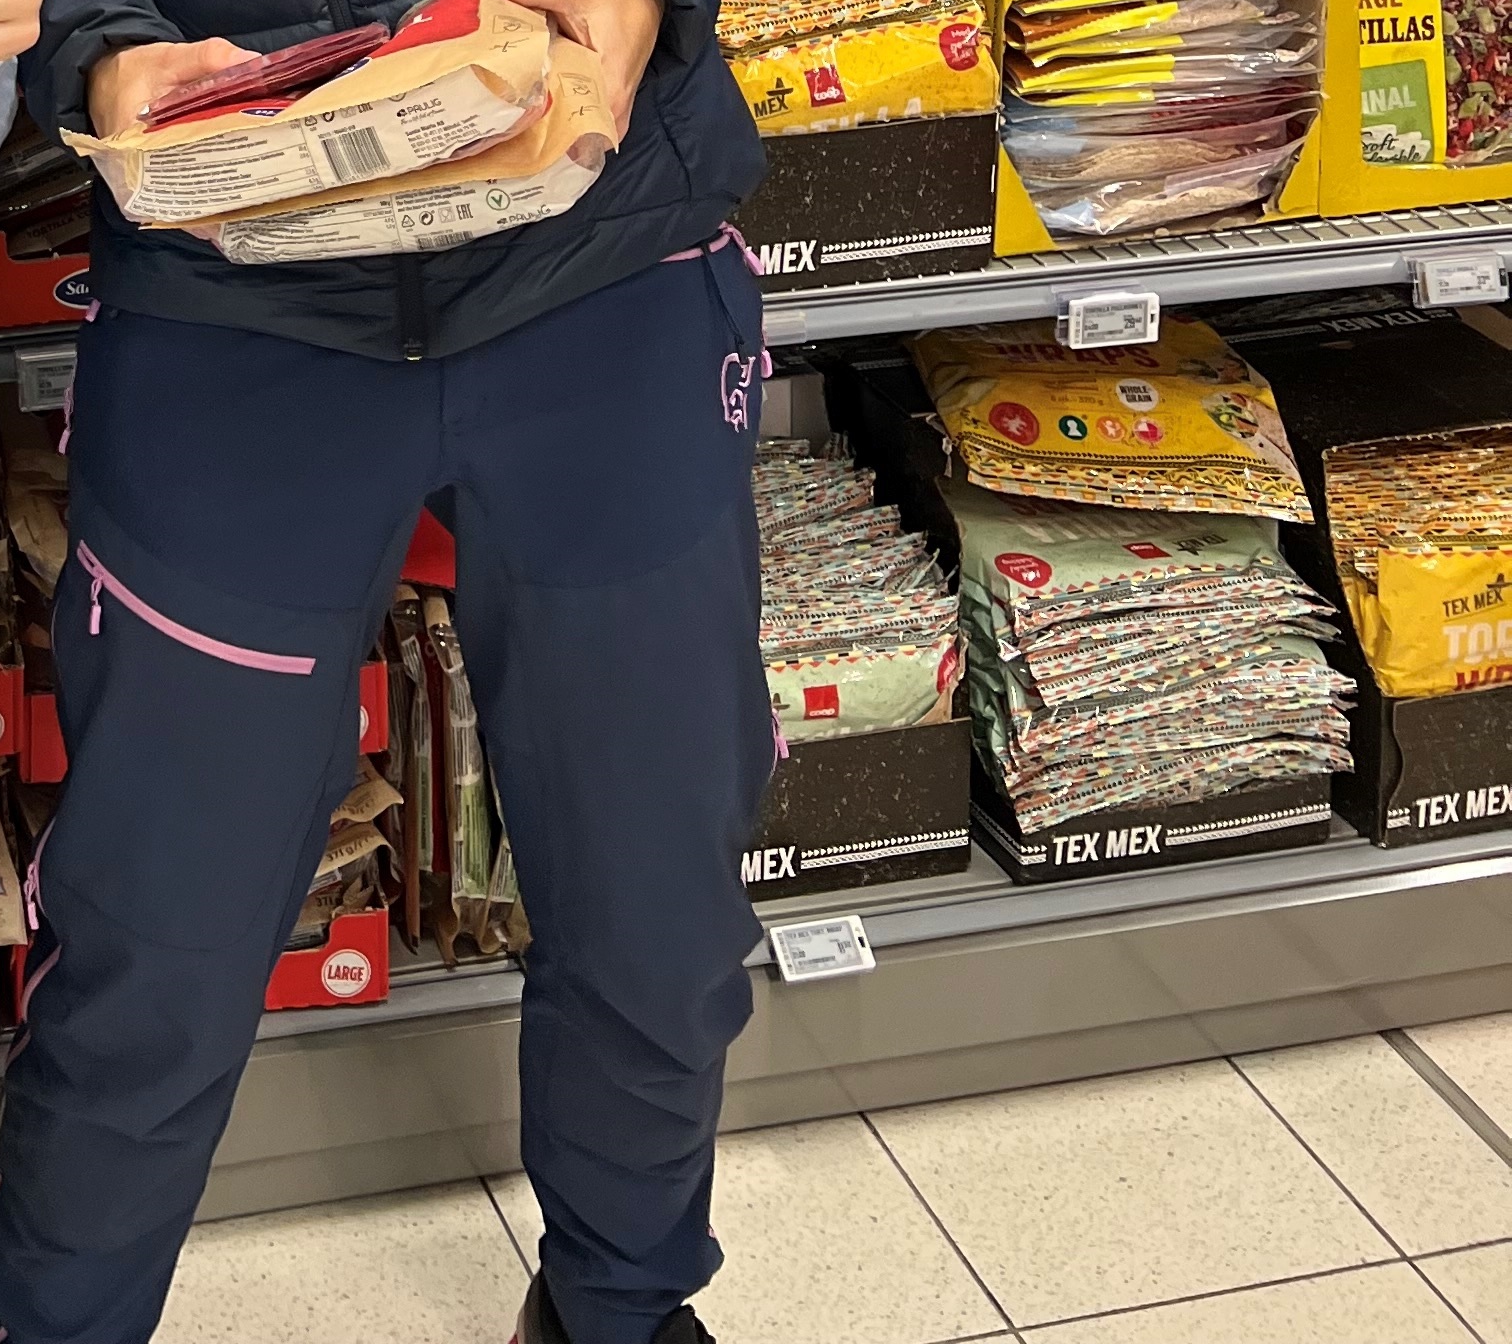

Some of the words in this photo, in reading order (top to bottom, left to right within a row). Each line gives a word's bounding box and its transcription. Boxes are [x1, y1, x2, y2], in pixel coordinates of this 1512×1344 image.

[814, 86, 840, 101] coop
[406, 98, 442, 115] PAULIG
[754, 96, 788, 118] MEX
[1119, 385, 1150, 394] WHOLE-
[1125, 394, 1152, 403] GRAIN
[1443, 597, 1470, 617] TEX
[1474, 588, 1504, 610] MEX
[1053, 834, 1102, 865] TEX
[1106, 825, 1162, 859] MEX
[741, 847, 796, 883] MEX
[327, 963, 364, 982] LARGE
